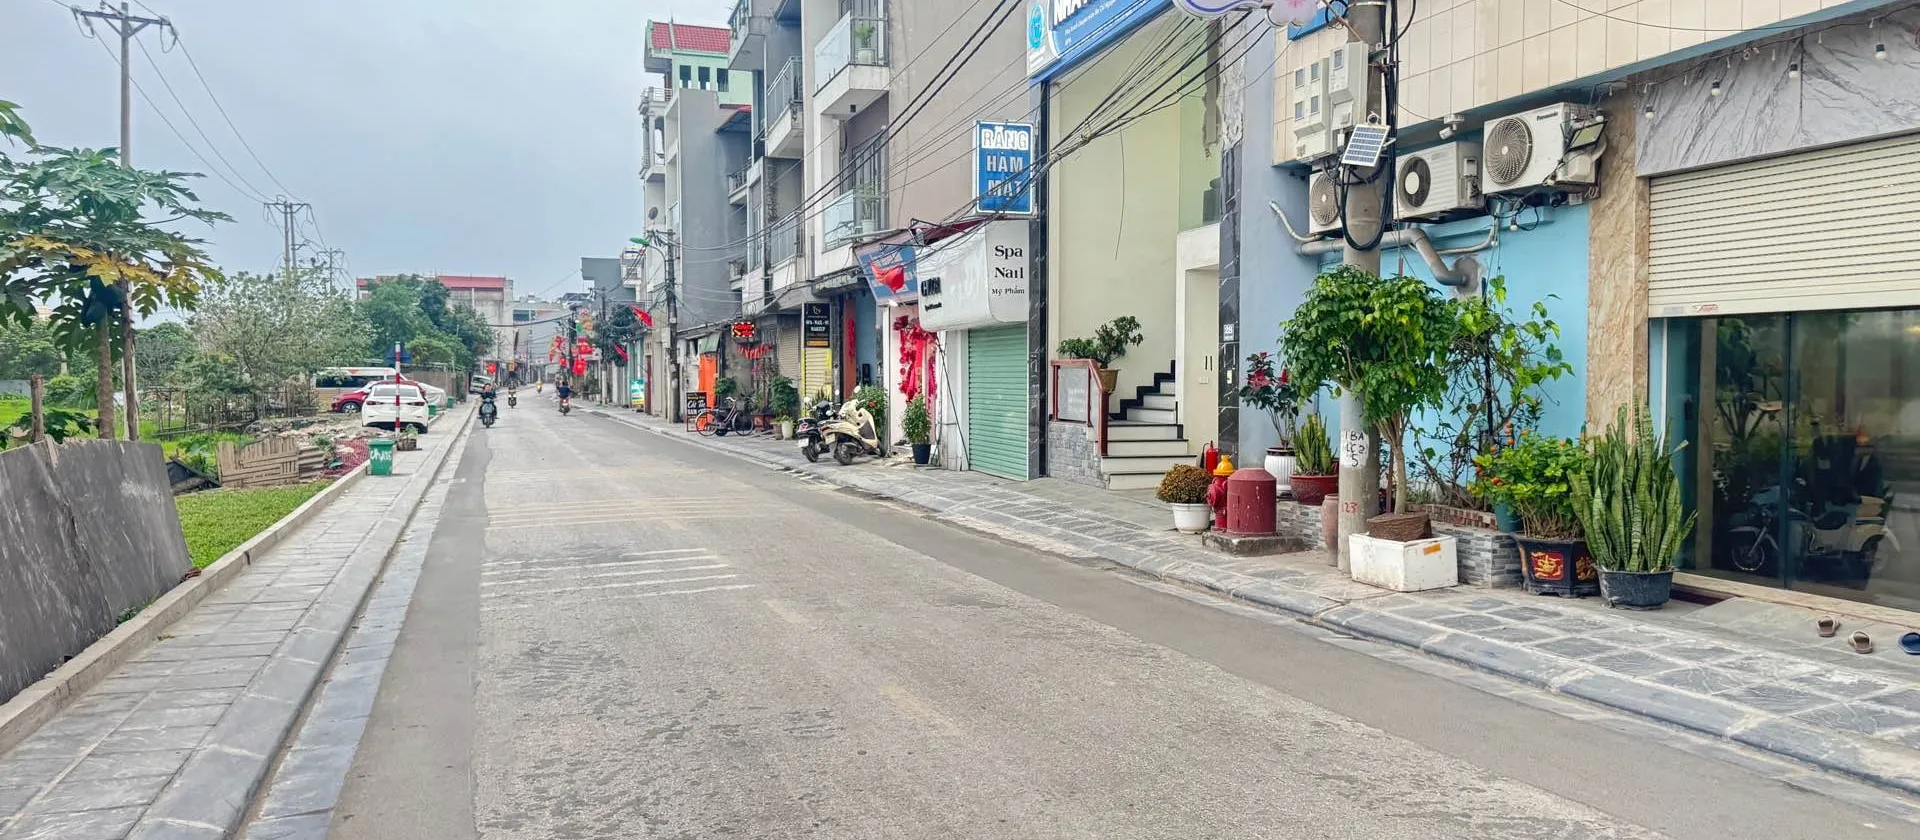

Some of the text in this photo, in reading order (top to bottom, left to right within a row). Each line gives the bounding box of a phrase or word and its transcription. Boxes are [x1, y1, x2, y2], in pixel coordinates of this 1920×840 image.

[981, 126, 1029, 151] RĂNG
[994, 244, 1023, 260] Spa
[994, 267, 1024, 279] Nail
[1351, 453, 1359, 467] 5
